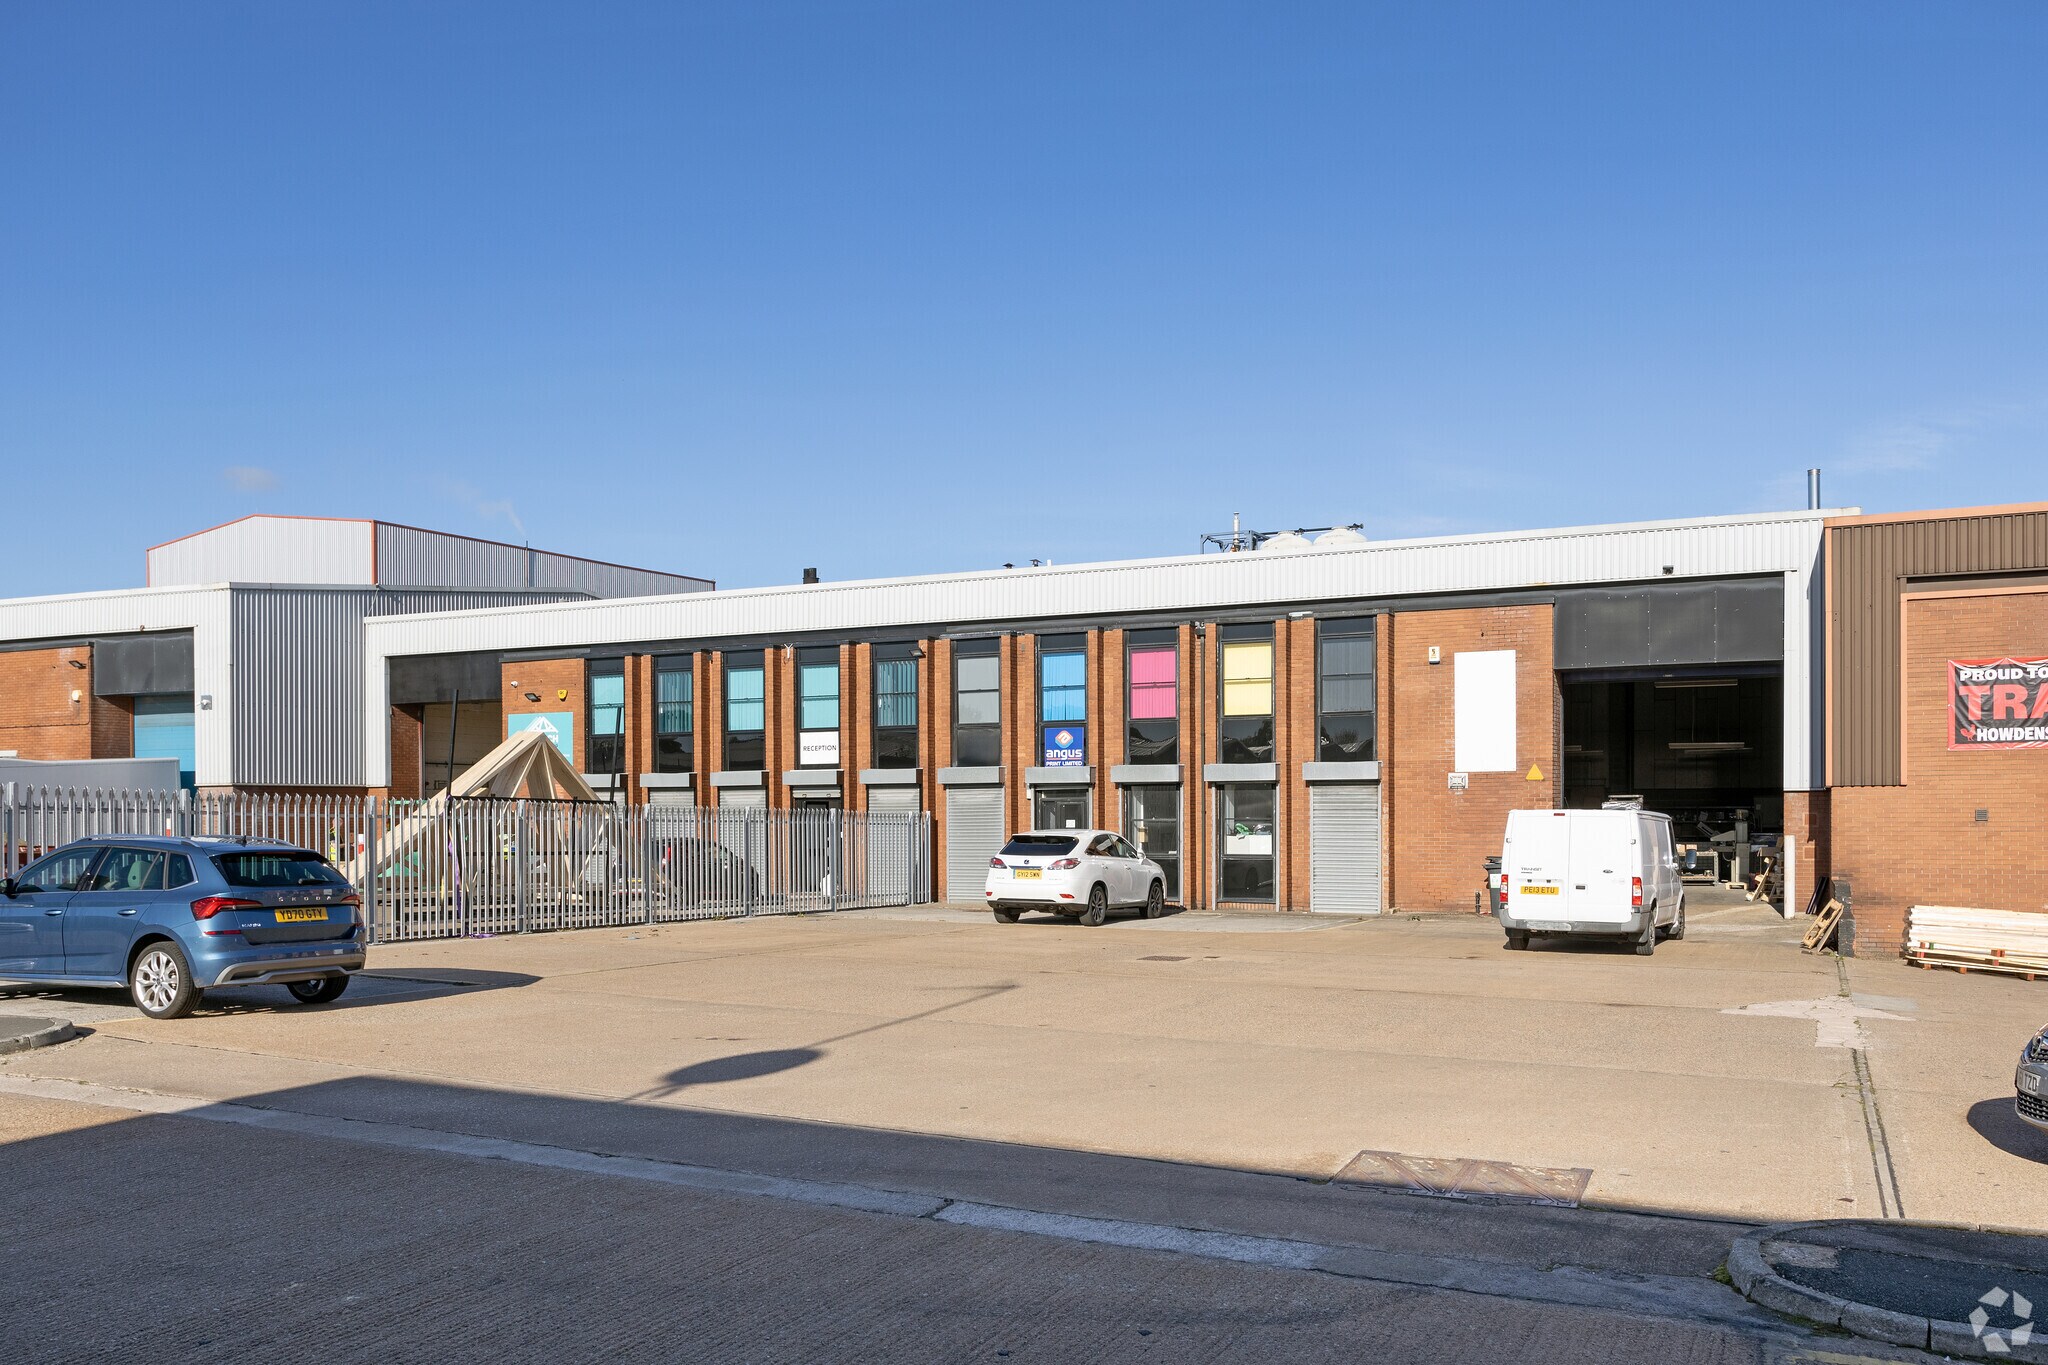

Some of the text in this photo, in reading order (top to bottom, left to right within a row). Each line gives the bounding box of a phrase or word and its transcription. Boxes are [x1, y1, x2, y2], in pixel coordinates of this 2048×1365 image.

[1960, 666, 2048, 681] PROUD TO
[1046, 749, 1082, 760] angus
[1524, 886, 1555, 894] PE13 ETU
[280, 908, 323, 920] YD70 GTY
[2025, 1072, 2038, 1092] TZD
